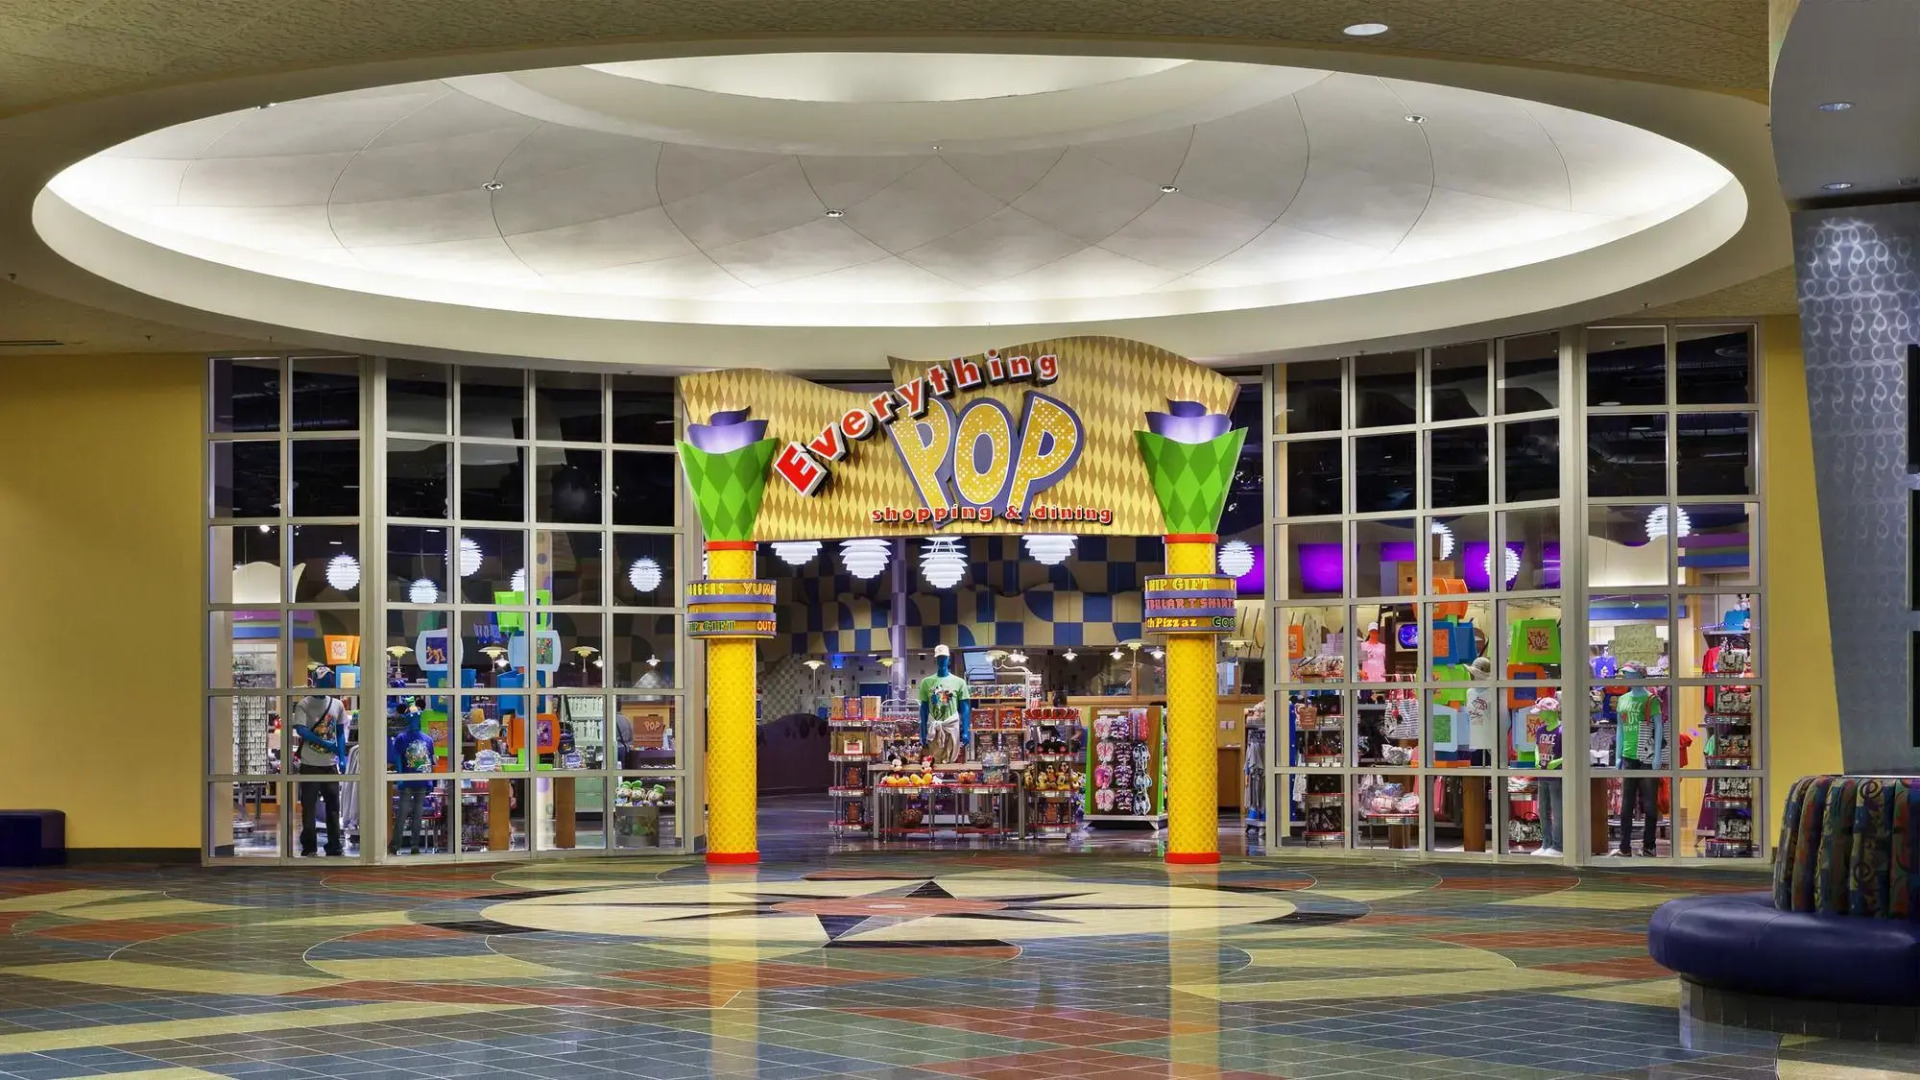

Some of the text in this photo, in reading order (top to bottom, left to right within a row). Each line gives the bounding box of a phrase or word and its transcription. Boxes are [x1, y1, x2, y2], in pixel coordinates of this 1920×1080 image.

[774, 349, 1058, 497] Everything
[885, 392, 1081, 523] POP
[872, 504, 1113, 524] shopping & dining
[1172, 577, 1211, 590] GIFT
[1200, 598, 1235, 608] SHIRT
